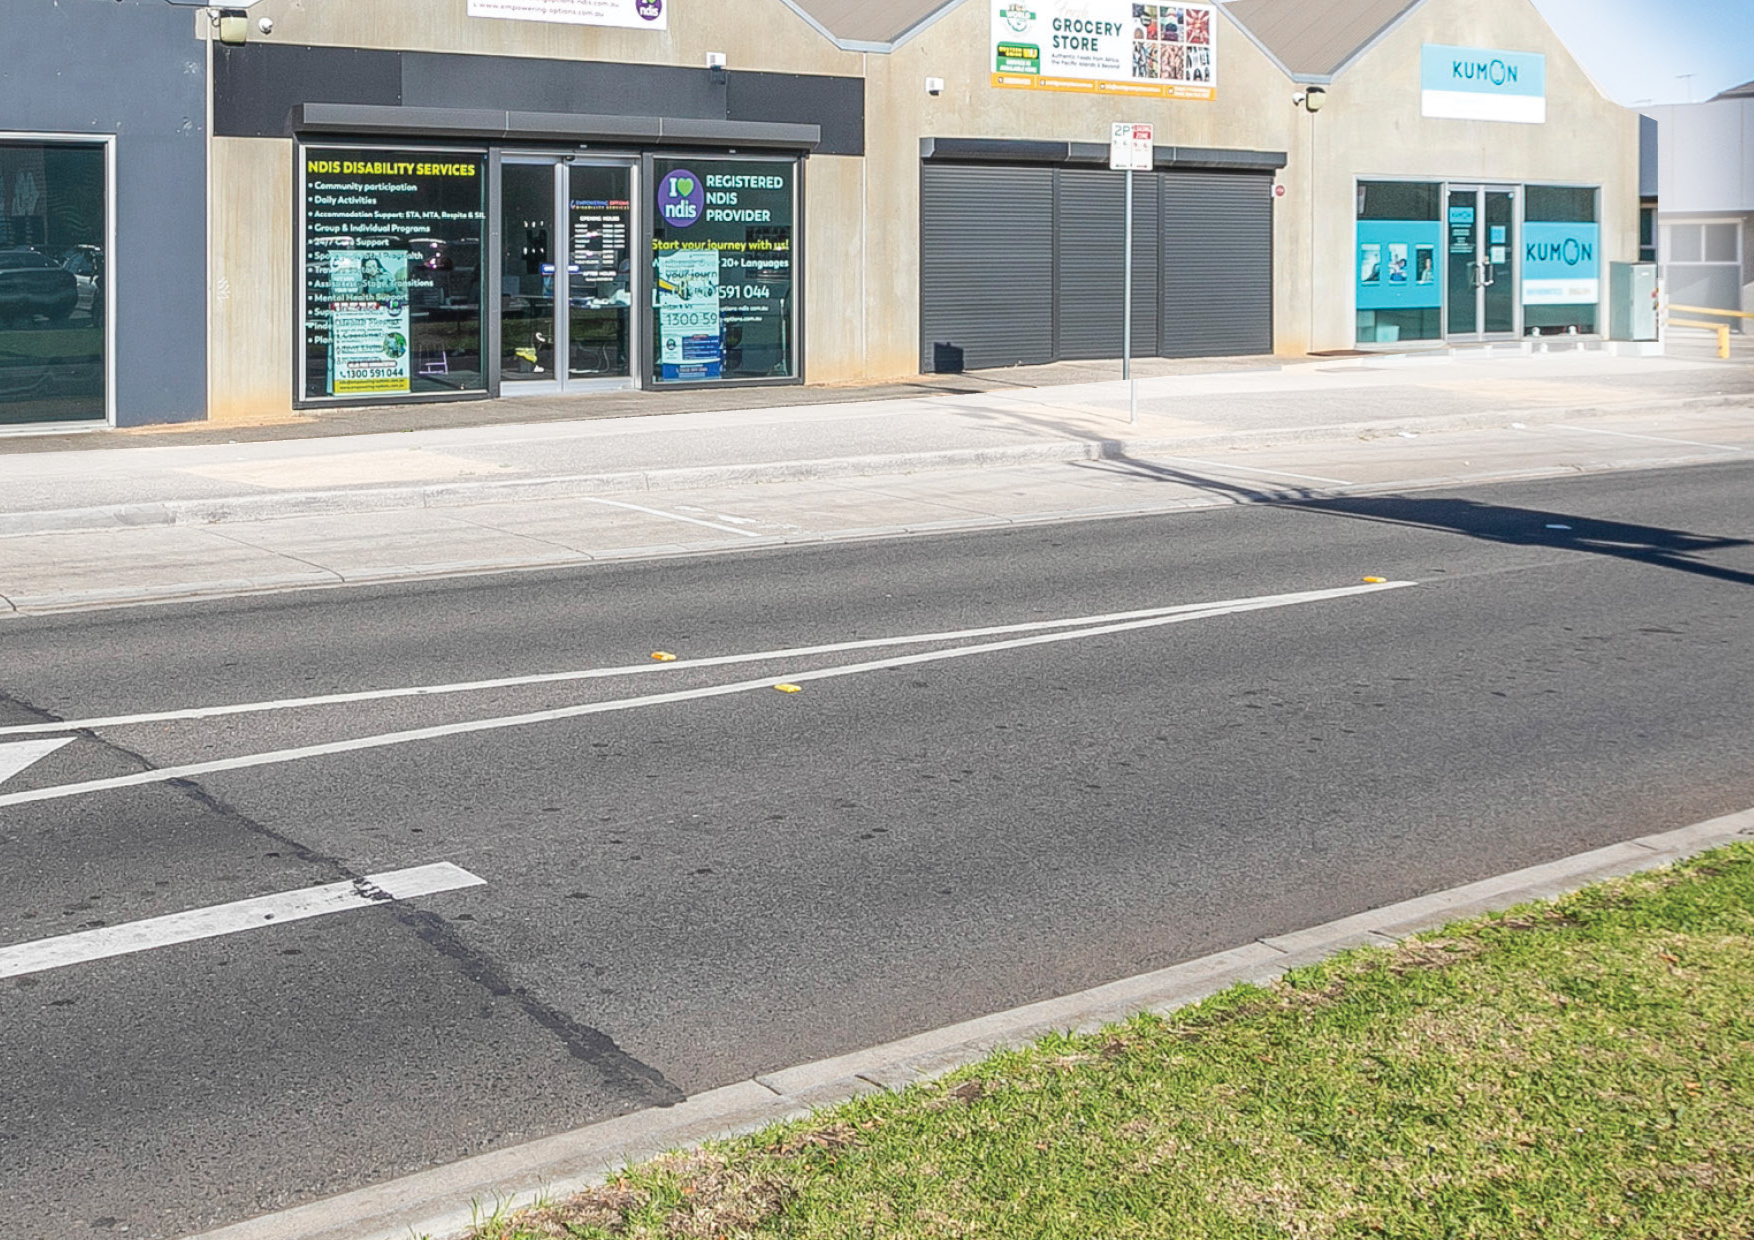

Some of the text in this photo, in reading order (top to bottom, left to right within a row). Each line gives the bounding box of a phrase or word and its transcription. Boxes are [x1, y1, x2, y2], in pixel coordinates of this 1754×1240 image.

[1052, 17, 1122, 37] GROCERY
[1052, 36, 1099, 51] STORE
[1452, 59, 1518, 86] KUMON
[1114, 124, 1130, 136] 2P
[307, 160, 475, 176] NDIS DISABILITY SERVICES
[314, 181, 418, 192] Community participation
[669, 177, 677, 197] I
[705, 174, 784, 189] REGISTERED
[314, 195, 377, 206] Daily Activities
[706, 191, 738, 205] NDIS
[665, 199, 697, 218] ndis
[706, 209, 771, 222] PROVIDER
[314, 224, 340, 234] Group
[350, 224, 391, 233] Individual
[391, 224, 431, 235] Programs
[356, 238, 390, 248] Support
[651, 239, 789, 252] Start your journey with us!
[1526, 237, 1592, 266] KUMON
[720, 257, 739, 268] 20+
[740, 257, 789, 269] Languages
[743, 284, 770, 299] 044
[347, 368, 404, 379] 1300 591 044
